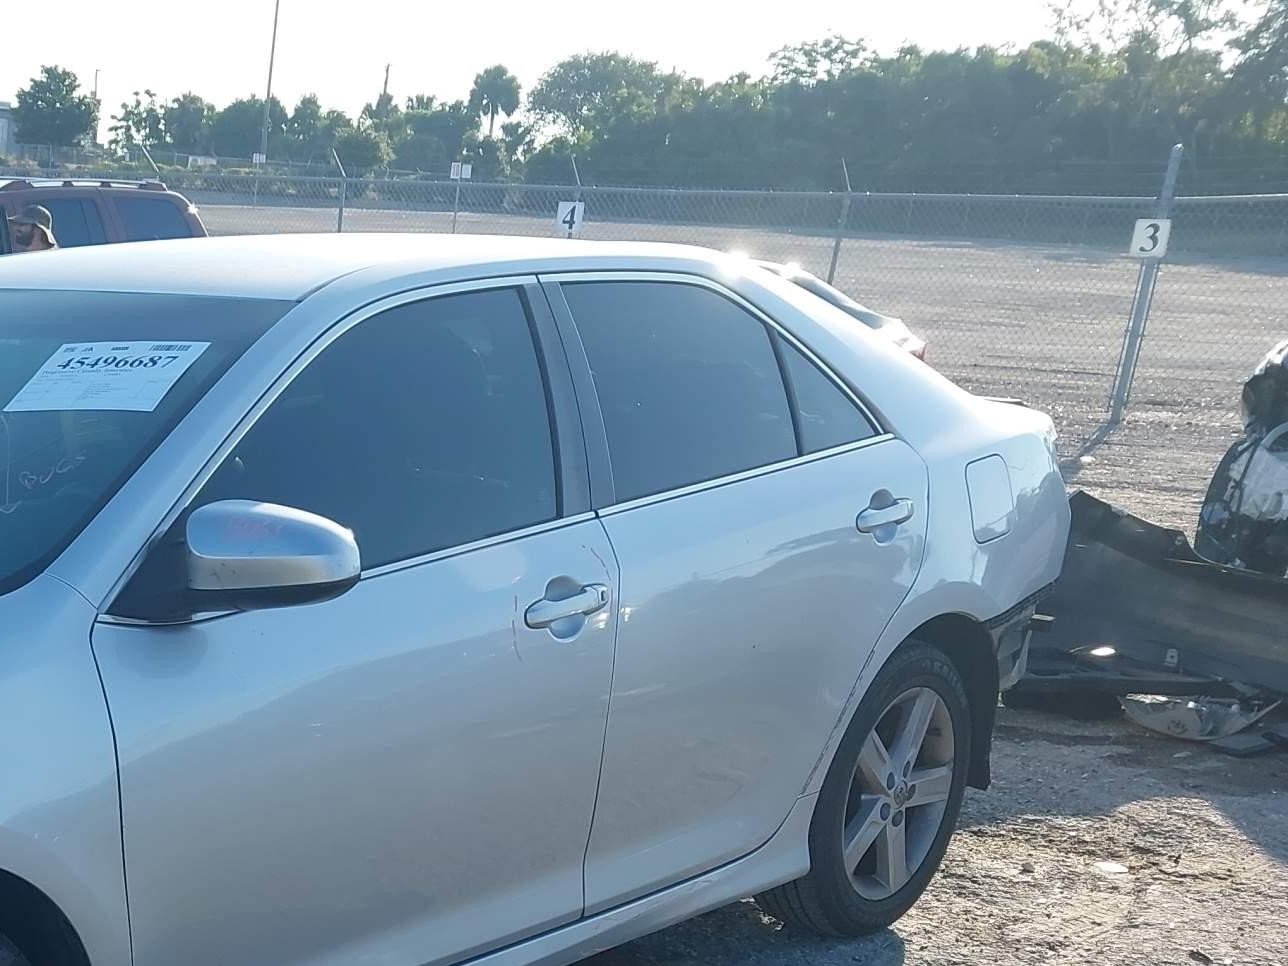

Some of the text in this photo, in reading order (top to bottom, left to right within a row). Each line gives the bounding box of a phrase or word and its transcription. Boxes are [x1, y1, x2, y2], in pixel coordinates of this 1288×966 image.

[562, 204, 576, 230] 4
[1138, 223, 1160, 252] 3
[57, 355, 179, 370] 45496687
